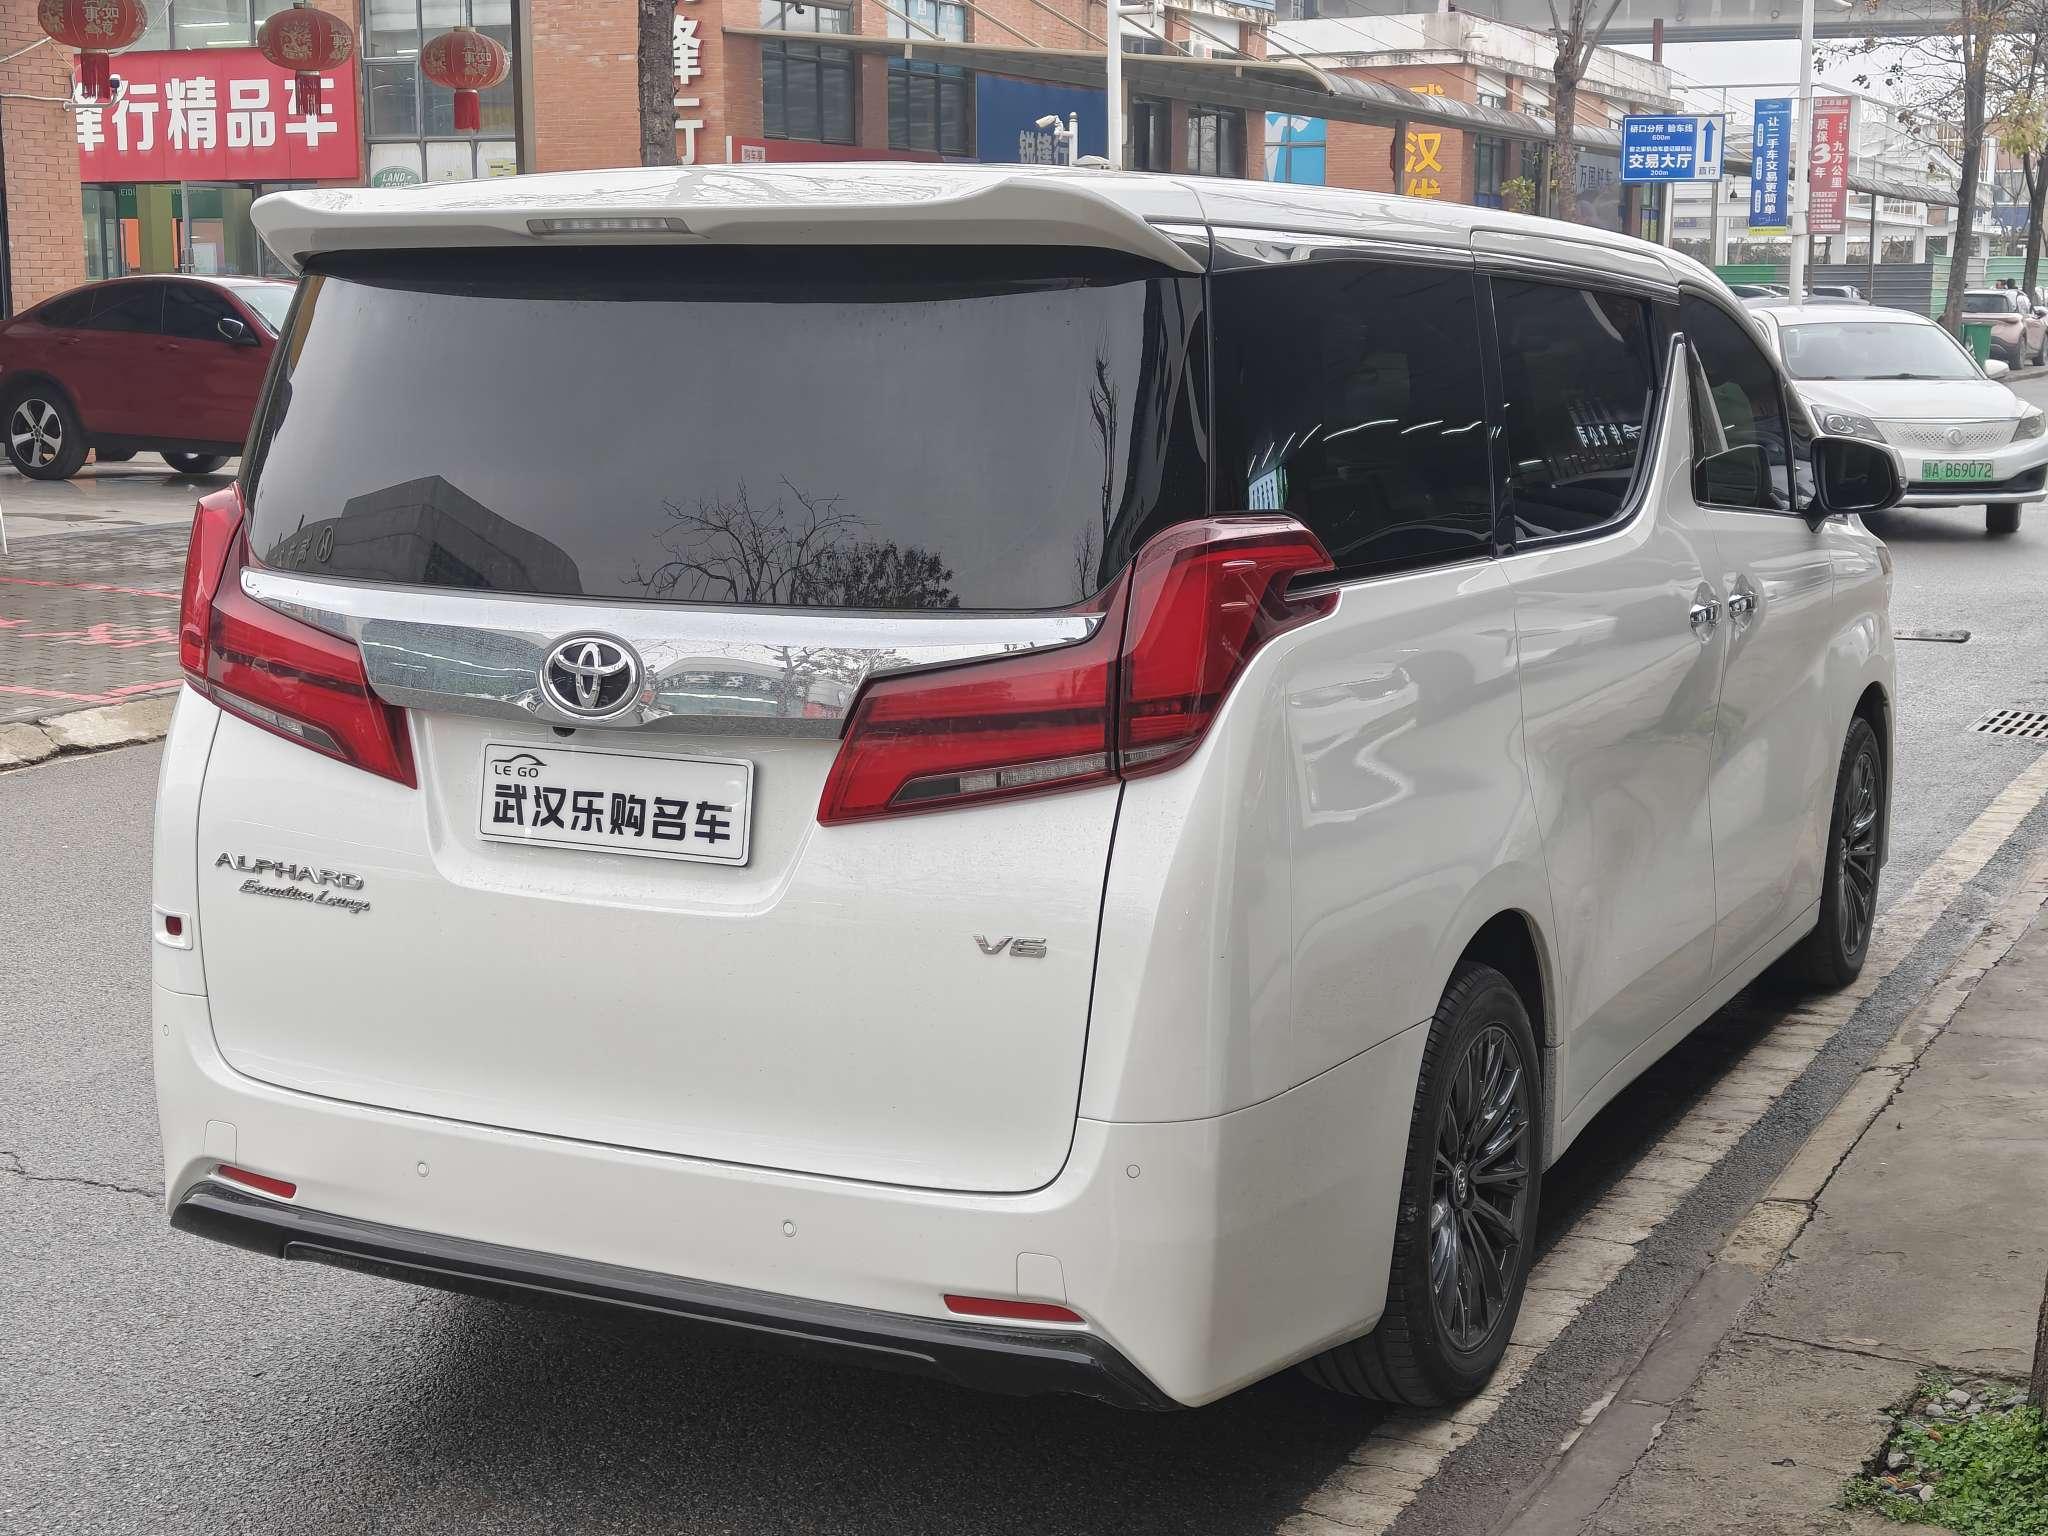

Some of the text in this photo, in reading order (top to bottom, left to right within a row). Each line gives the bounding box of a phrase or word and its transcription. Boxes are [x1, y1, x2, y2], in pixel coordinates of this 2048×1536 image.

[1629, 153, 1692, 168] 交易大厅
[1764, 116, 1780, 215] 让二手车交易更简单
[1831, 140, 1846, 188] 九万公里
[383, 172, 406, 182] LAND
[494, 764, 539, 778] LE GO
[492, 784, 732, 844] 武汉乐购名车
[214, 851, 365, 891] ALPHARD
[973, 934, 1047, 959] V6
